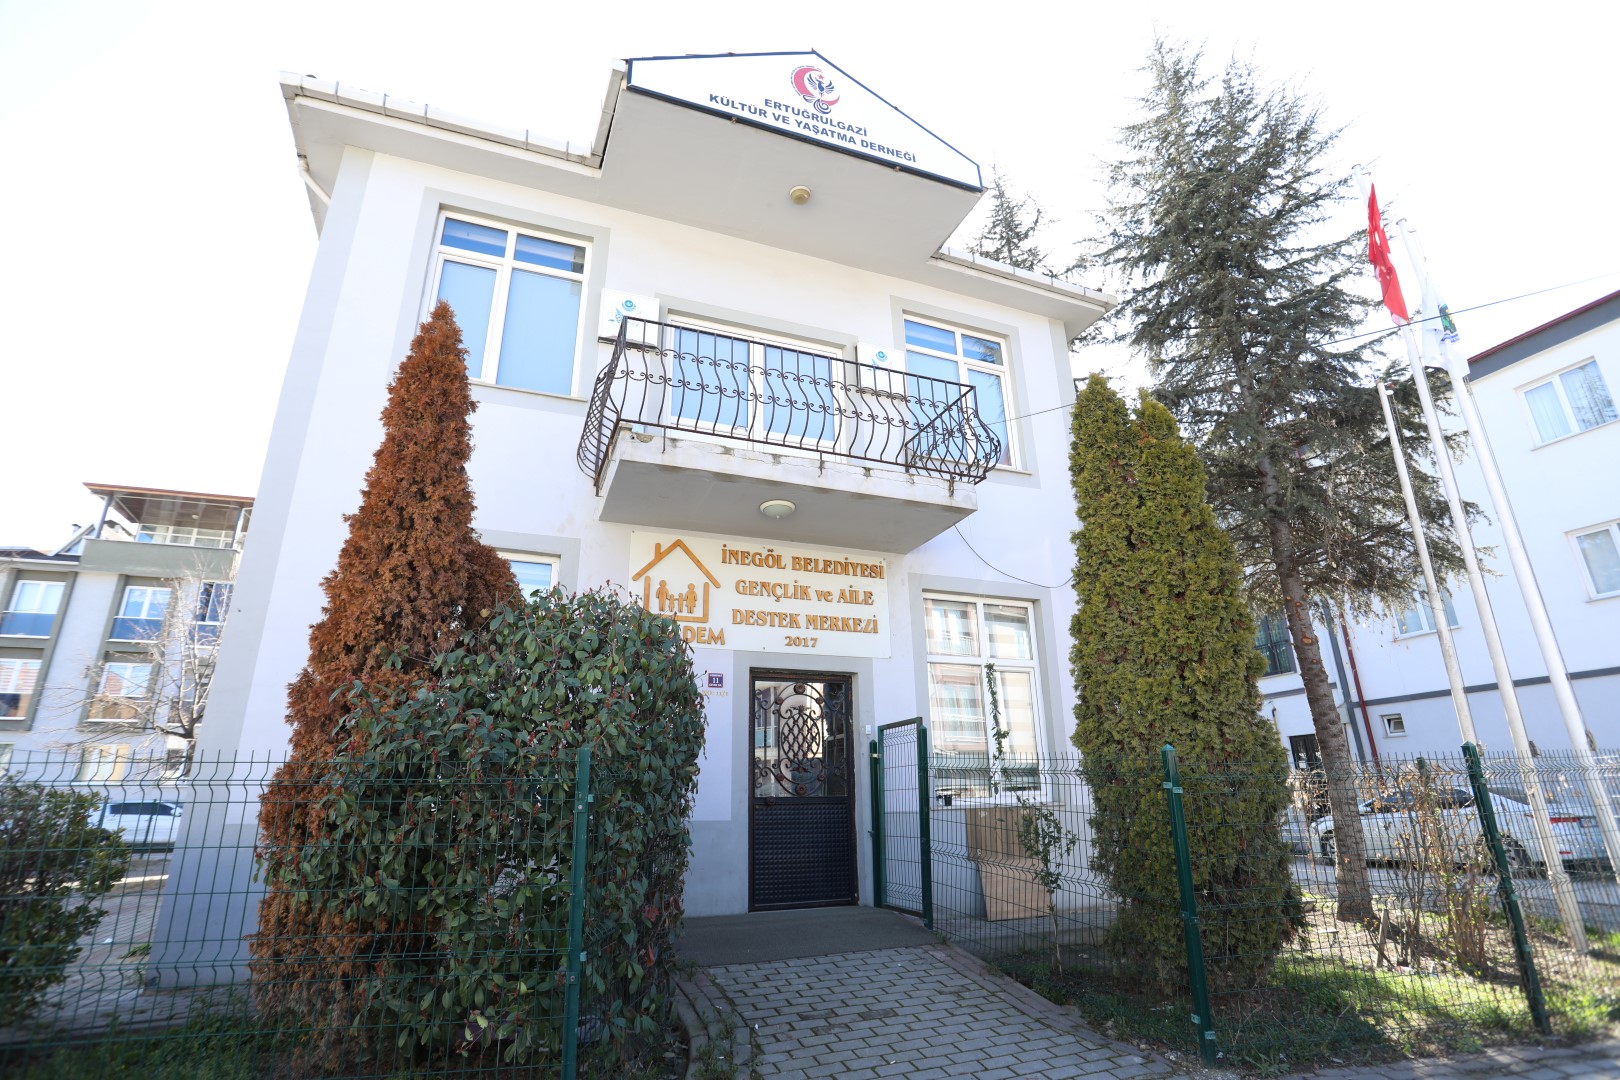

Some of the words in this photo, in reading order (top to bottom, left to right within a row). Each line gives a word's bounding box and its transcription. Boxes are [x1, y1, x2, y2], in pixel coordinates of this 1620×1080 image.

[709, 93, 768, 119] KÜLTÜR
[772, 112, 790, 125] VE
[795, 119, 857, 145] YAŞATMA
[860, 139, 917, 163] DERNEĞİ
[764, 98, 867, 137] ERTUĞRULGAZİ
[721, 543, 786, 570] İNEGÖL
[791, 556, 885, 580] BELEDİYESİ
[735, 579, 811, 603] GENÇLİK
[815, 589, 834, 602] ve
[837, 584, 874, 606] AİLE
[732, 608, 801, 630] DESTEK
[805, 614, 879, 635] MERKEZİ
[682, 625, 726, 646] DEM
[784, 635, 818, 648] 2017
